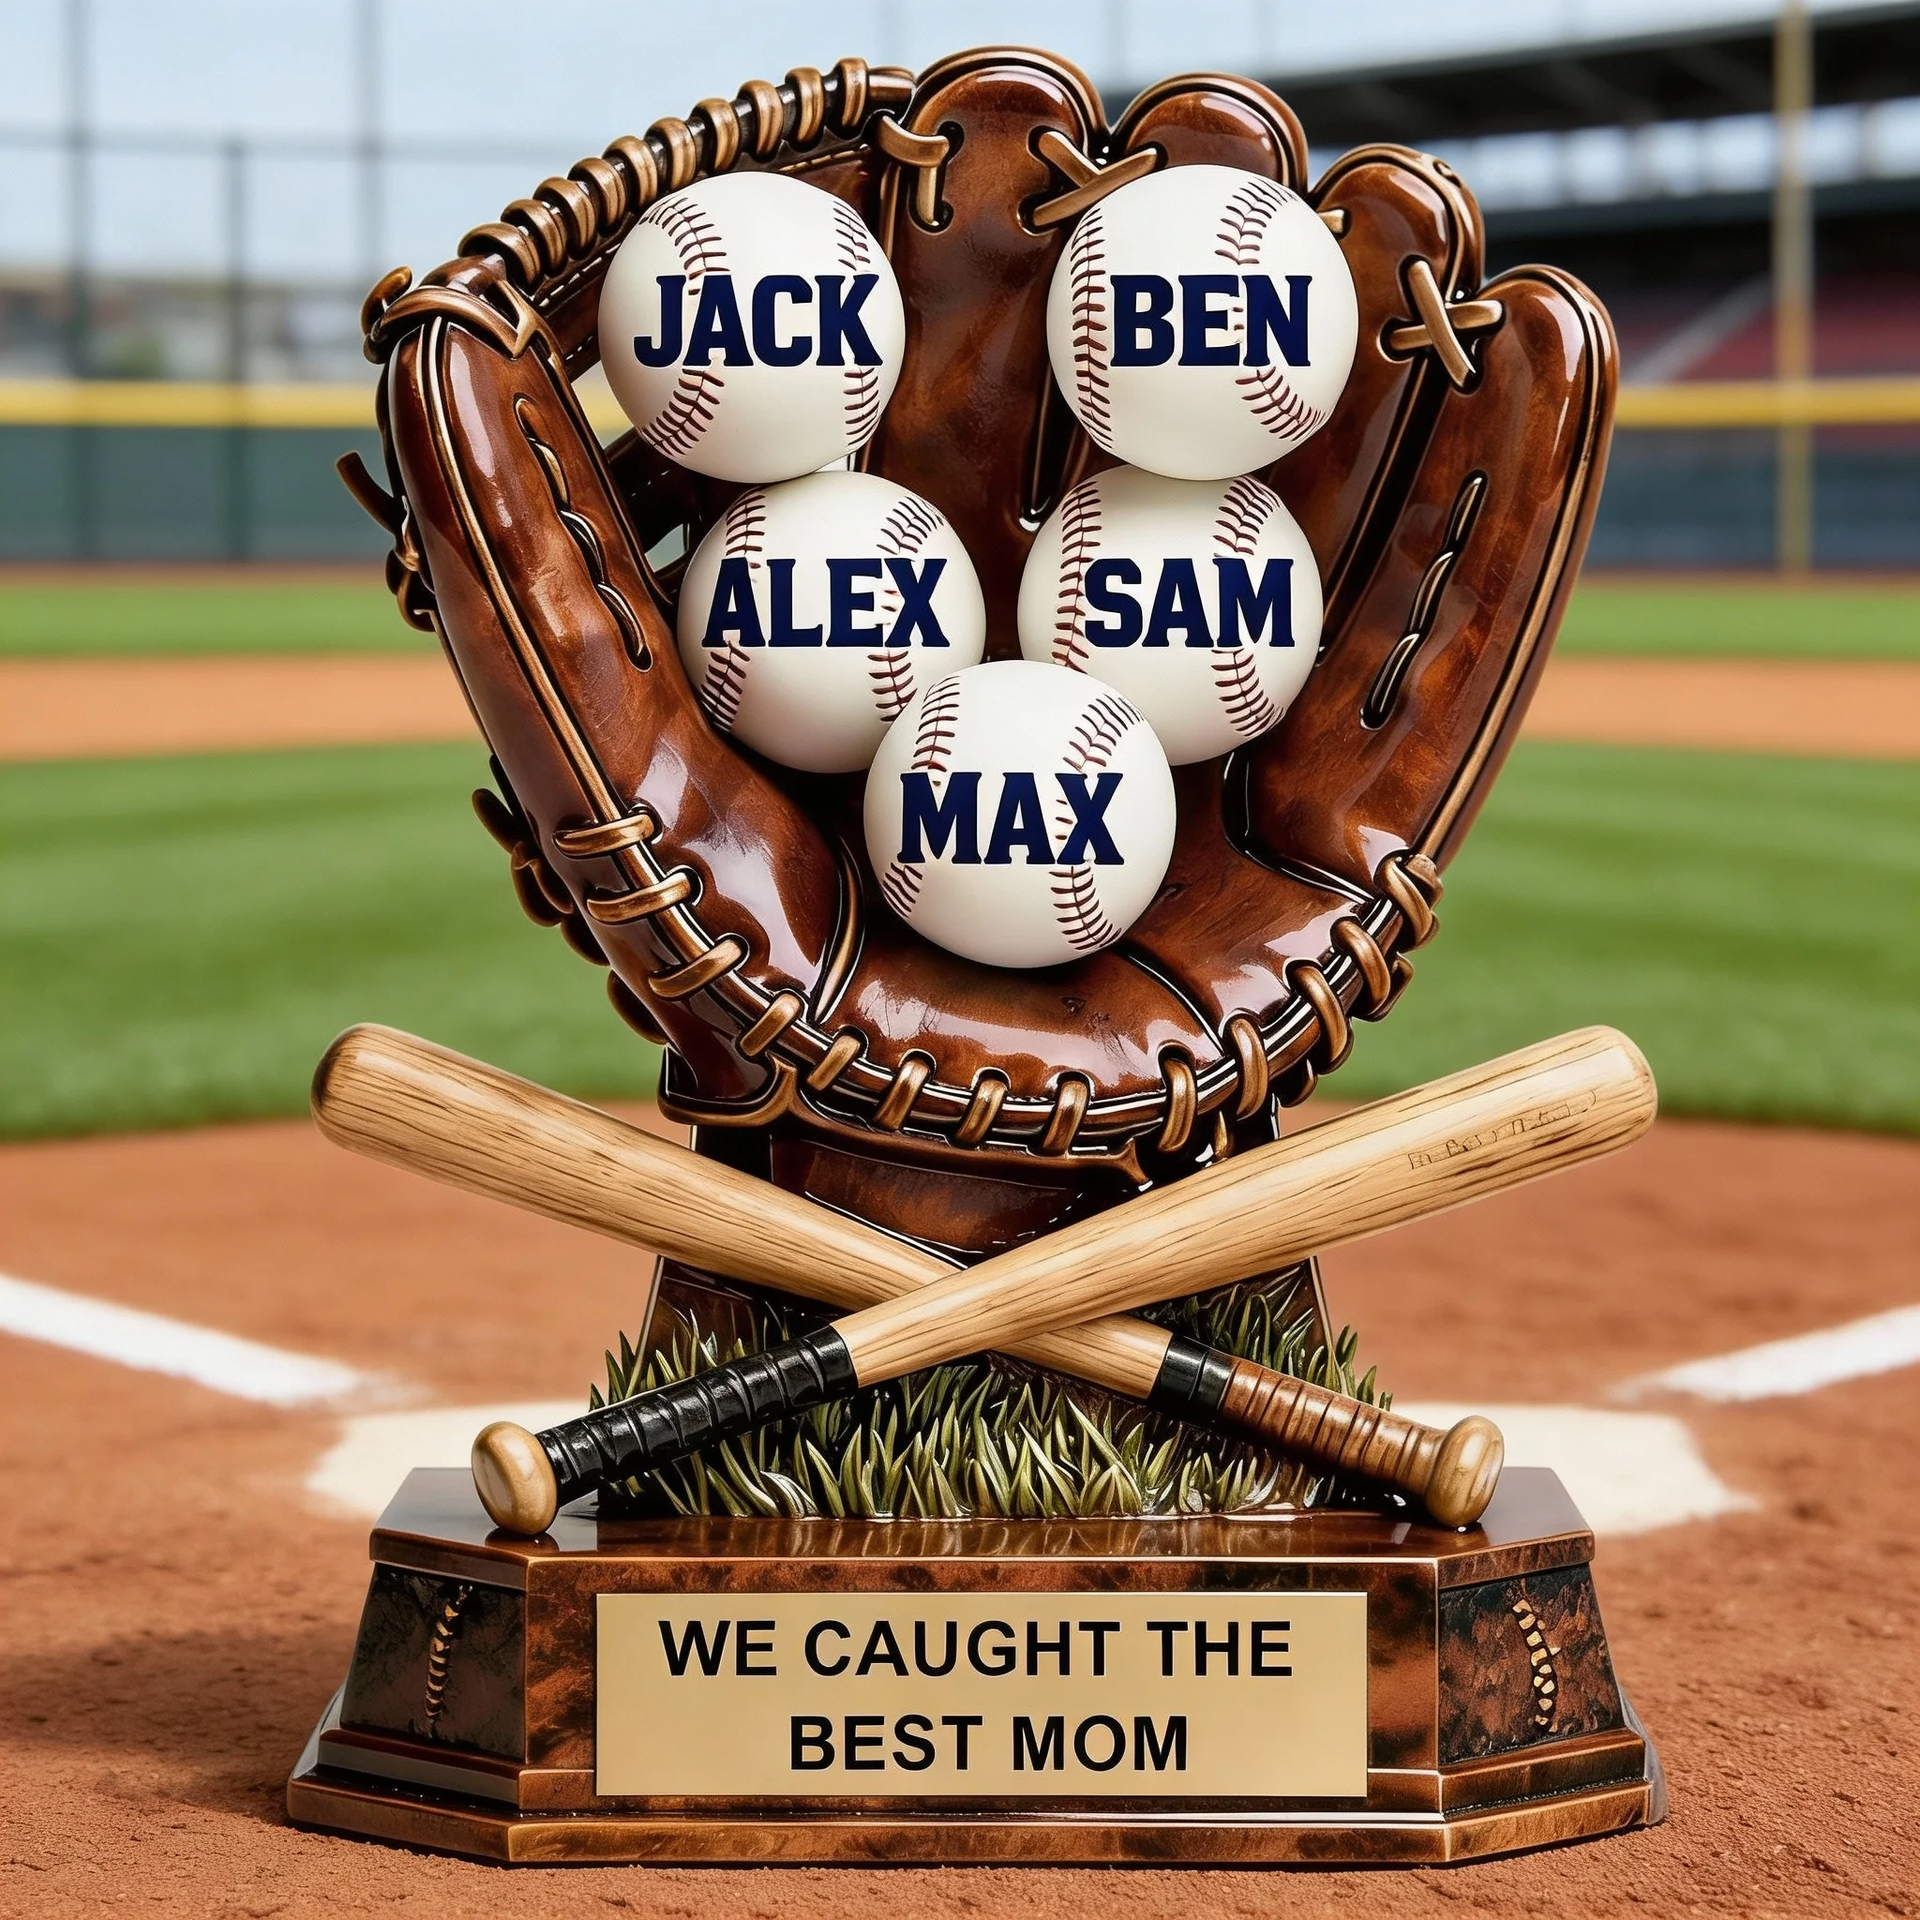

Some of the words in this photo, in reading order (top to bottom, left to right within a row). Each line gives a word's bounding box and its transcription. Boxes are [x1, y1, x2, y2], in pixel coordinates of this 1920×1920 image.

[633, 273, 883, 367] JACK
[1110, 274, 1312, 367] BEN
[702, 558, 950, 648] ALEX
[1084, 557, 1295, 648] SAM
[898, 771, 1124, 866] MAX
[657, 1620, 777, 1676] WE
[804, 1620, 1121, 1677] CAUGHT
[1146, 1620, 1293, 1677] THE
[790, 1714, 983, 1771] BEST
[1012, 1714, 1187, 1772] MOM
